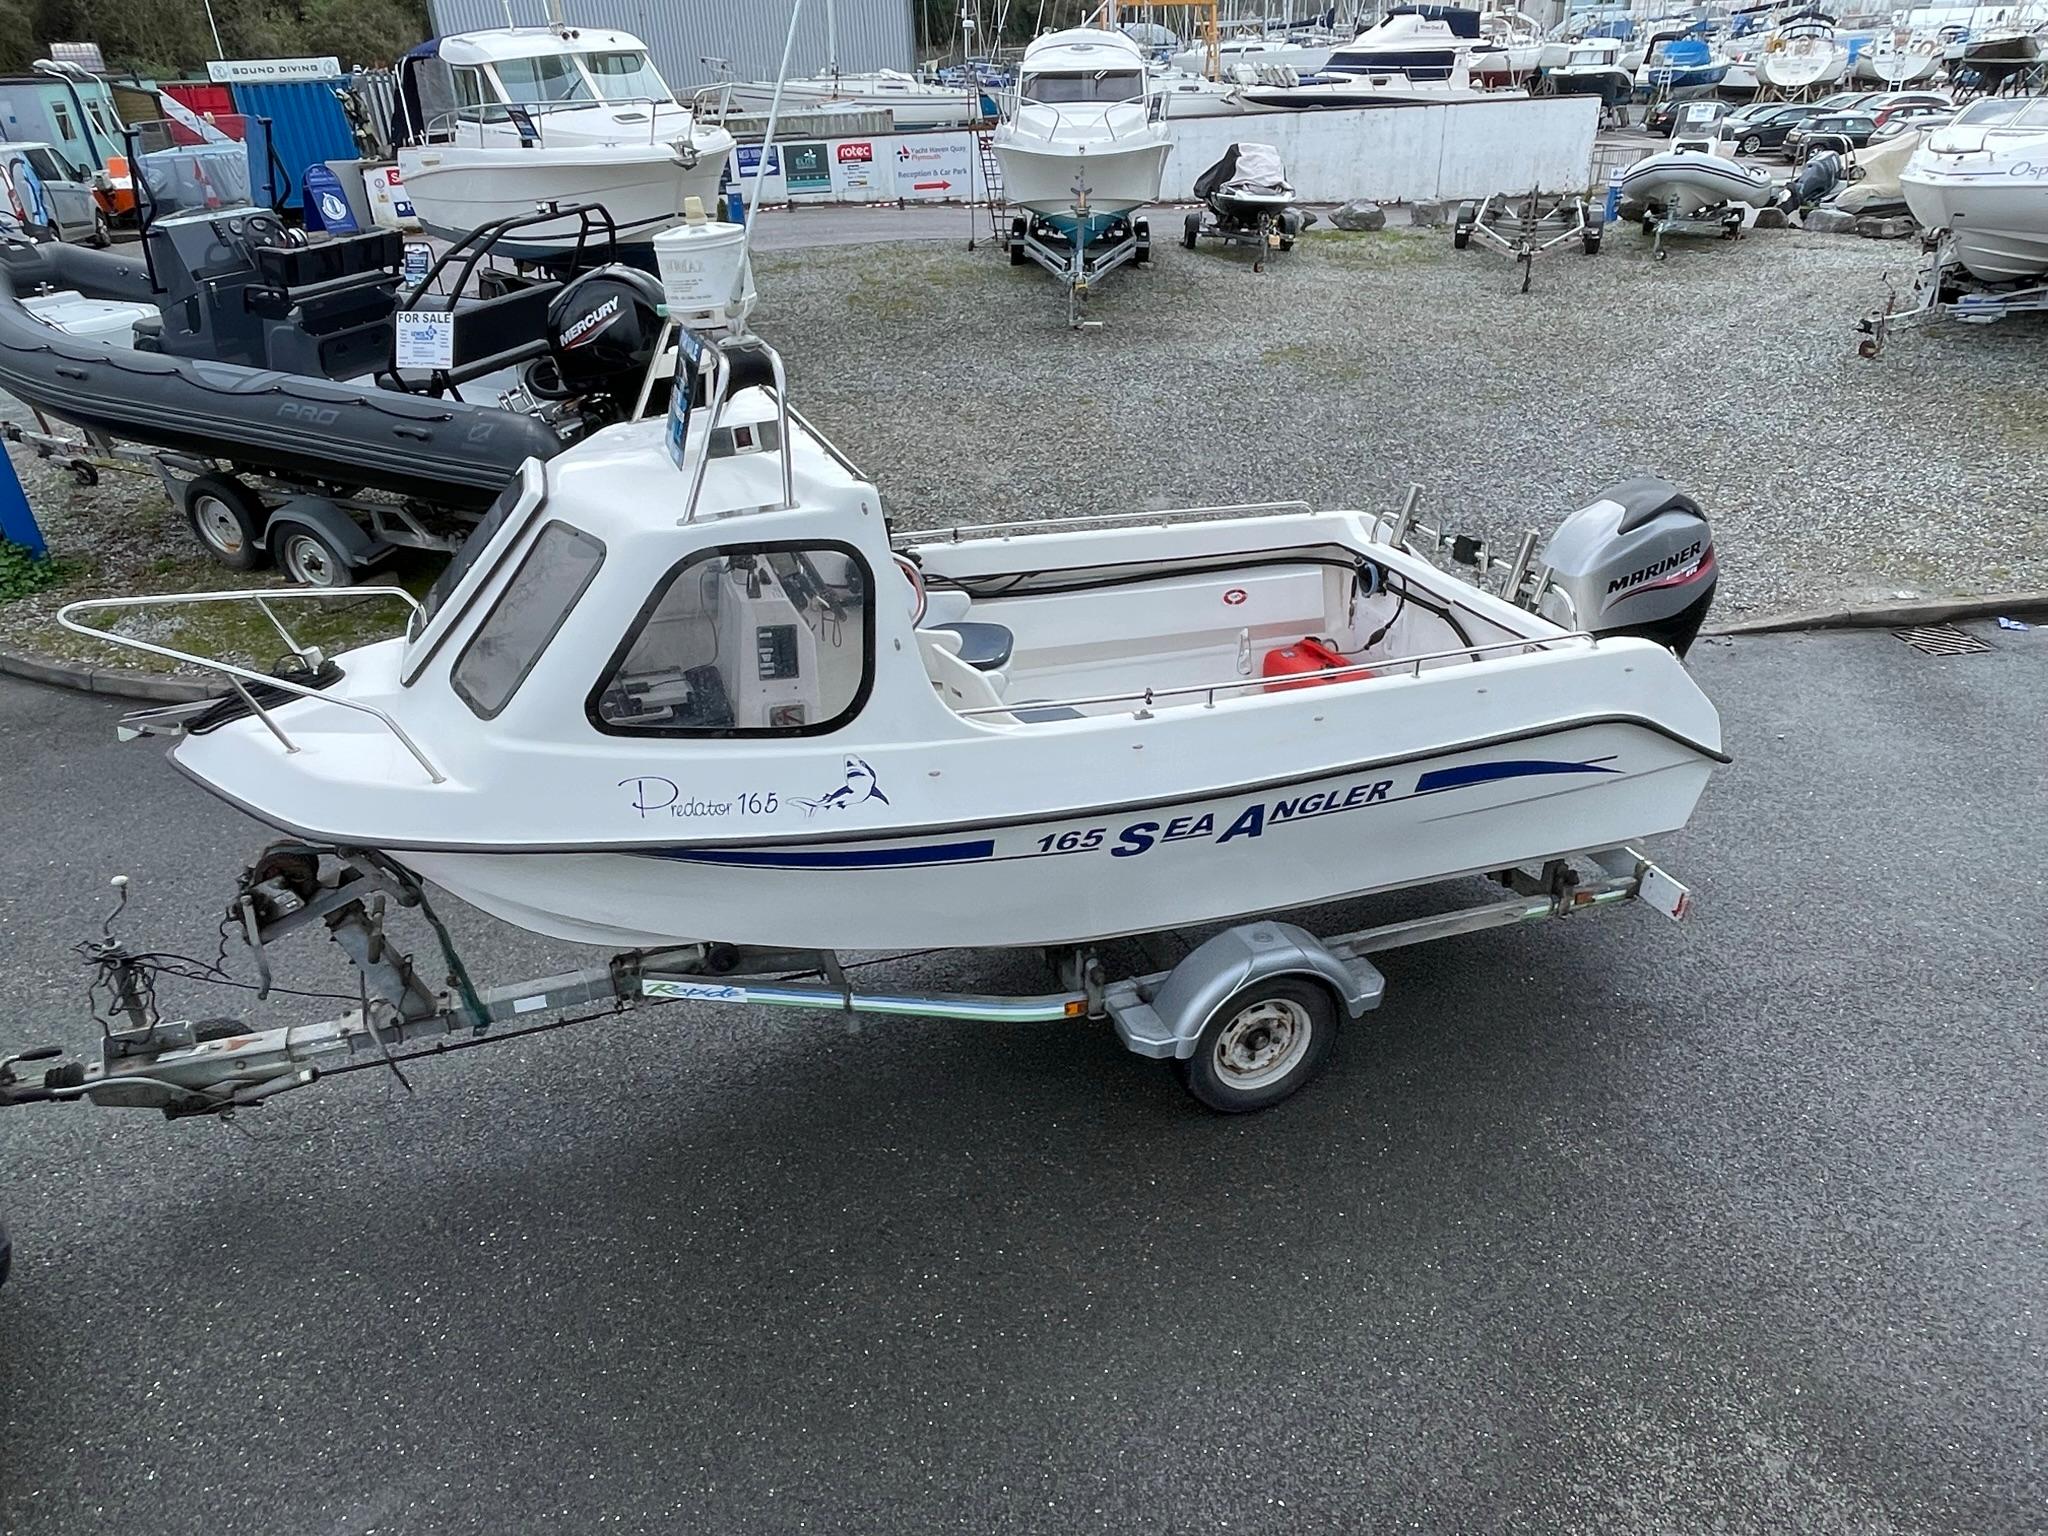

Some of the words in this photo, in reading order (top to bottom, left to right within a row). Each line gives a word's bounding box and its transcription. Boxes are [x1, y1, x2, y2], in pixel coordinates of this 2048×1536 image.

[231, 66, 275, 75] SOUND
[279, 64, 318, 73] DIVING
[840, 145, 870, 158] rotec
[950, 145, 966, 153] Quay
[898, 170, 932, 179] Reception
[940, 168, 951, 176] Car
[398, 313, 419, 323] FOR
[422, 313, 451, 323] SALE
[559, 295, 619, 347] MERCURY
[277, 403, 341, 425] PRO
[1607, 540, 1701, 594] MARINER
[618, 776, 732, 818] Predator
[737, 792, 779, 815] 165
[1036, 828, 1107, 852] 165
[1110, 813, 1215, 857] SEA
[1215, 780, 1394, 844] ANGLER
[646, 984, 742, 999] Rapide
